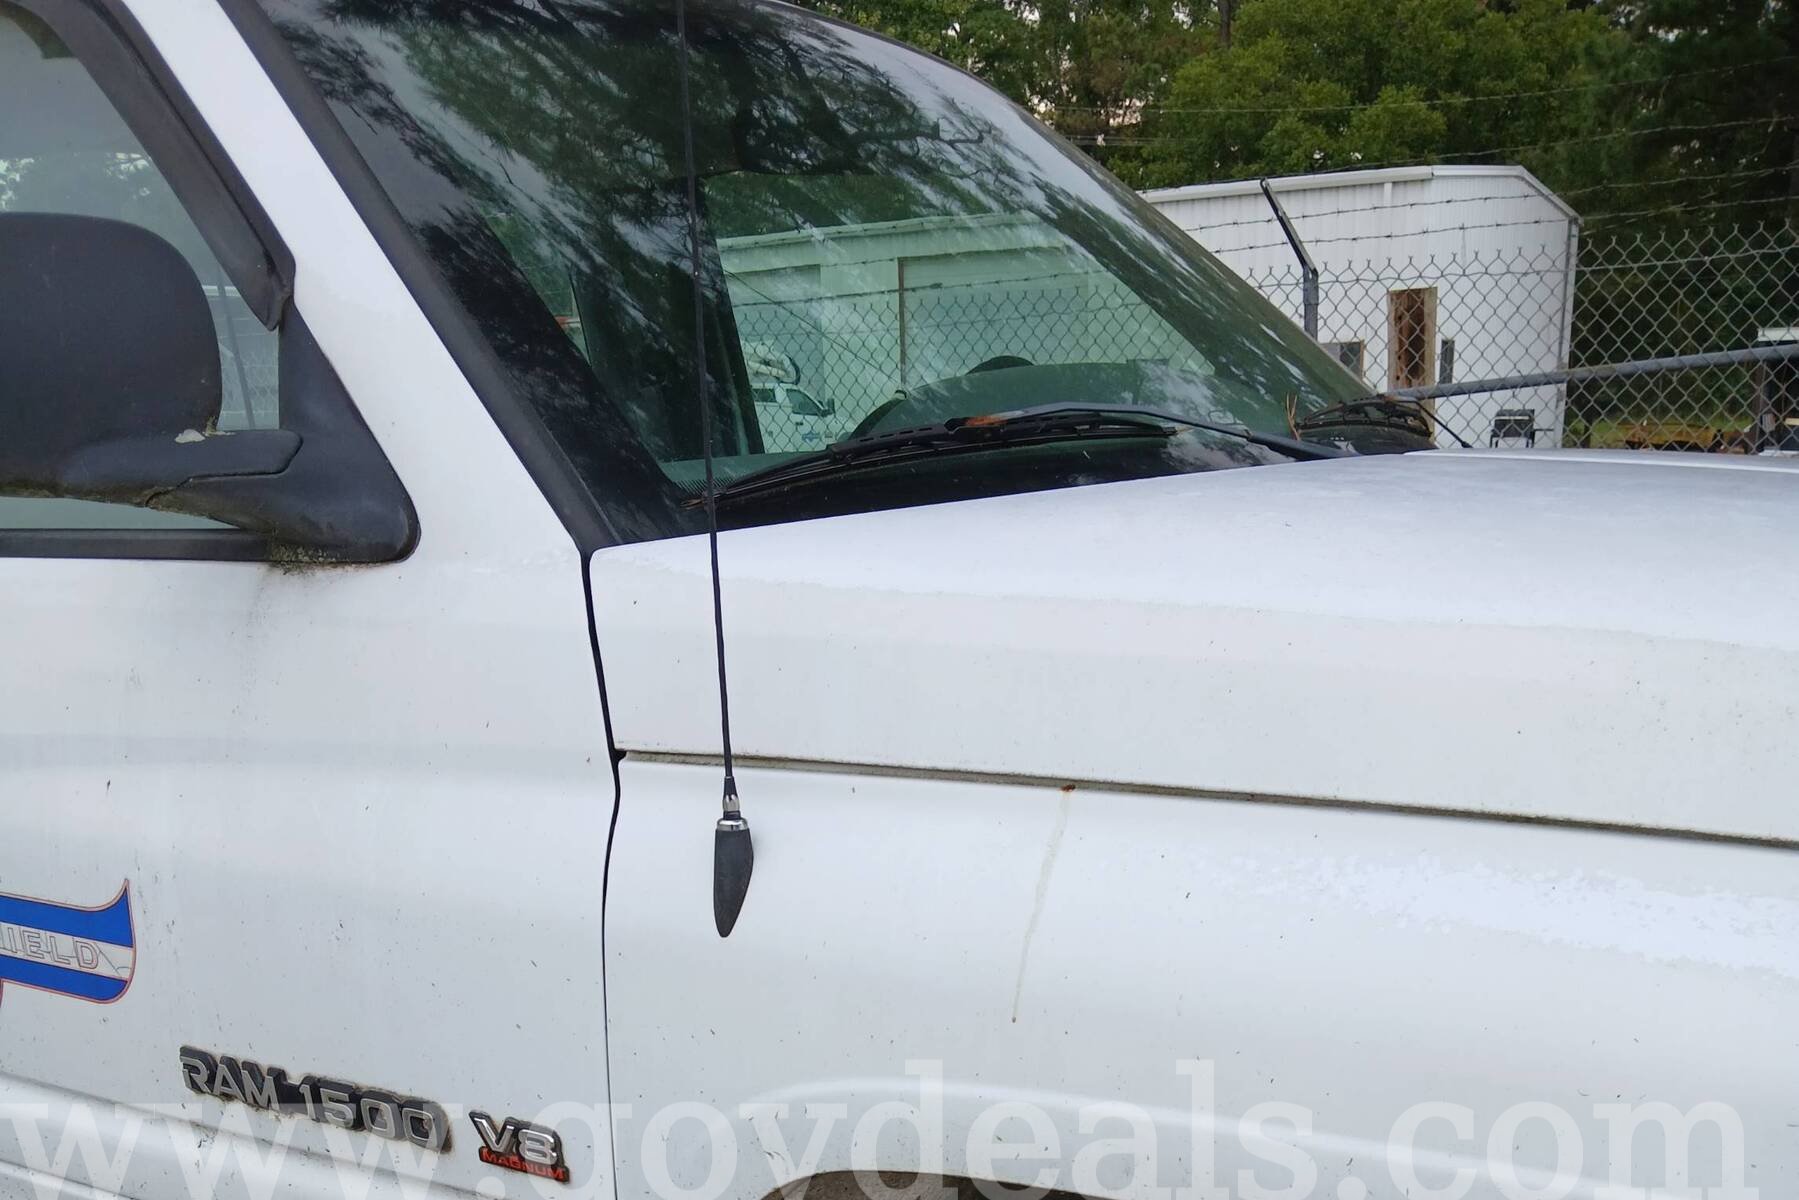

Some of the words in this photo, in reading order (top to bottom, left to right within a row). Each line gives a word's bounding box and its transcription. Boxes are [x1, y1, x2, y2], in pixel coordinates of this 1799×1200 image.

[180, 1049, 281, 1111] RAM
[299, 1078, 446, 1152] 1500
[470, 1113, 560, 1166] V8
[481, 1147, 565, 1180] MAGNUM
